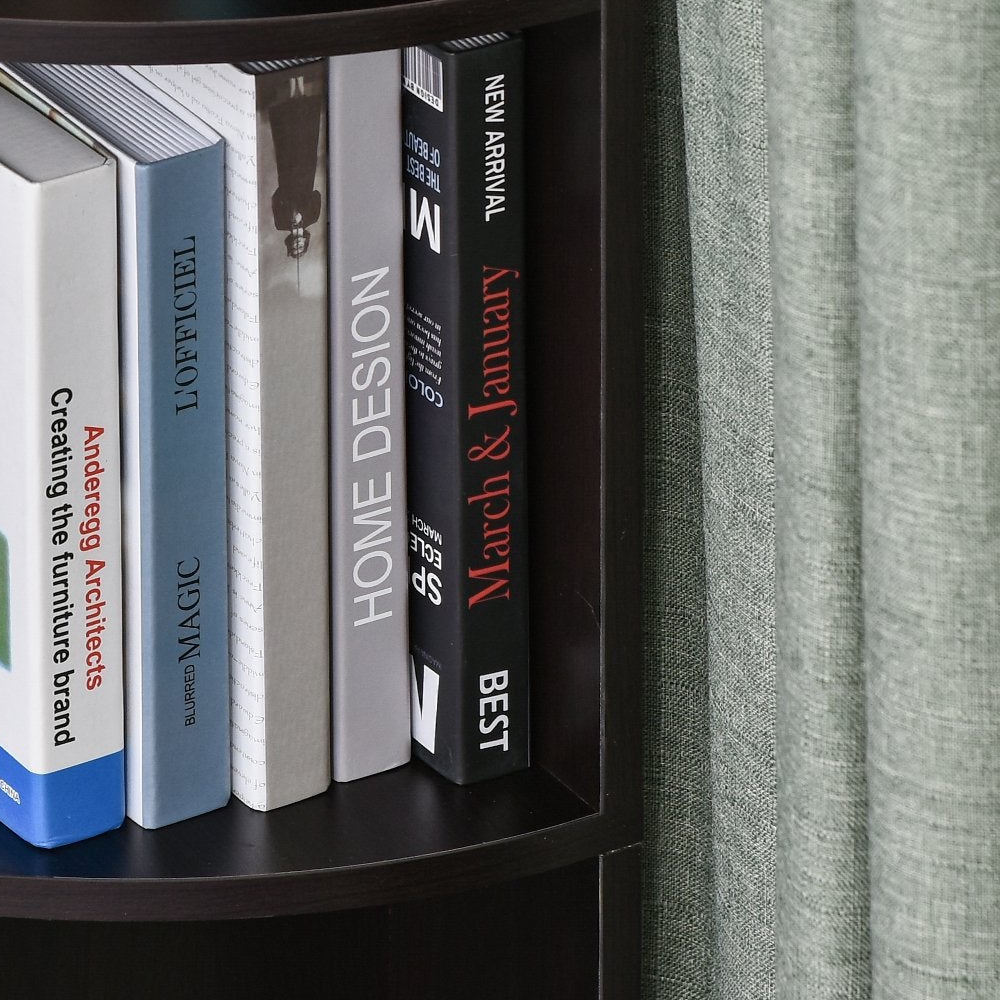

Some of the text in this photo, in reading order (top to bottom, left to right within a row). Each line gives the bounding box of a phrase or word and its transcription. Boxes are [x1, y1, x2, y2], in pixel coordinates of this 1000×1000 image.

[406, 154, 441, 193] THE BEST
[429, 146, 441, 168] OF
[484, 73, 506, 222] NEW ARRIVAL
[410, 187, 441, 254] M
[173, 235, 198, 416] L'OFFICIEL
[409, 373, 444, 408] COLO
[467, 265, 520, 610] March & January
[46, 387, 76, 747] Creating the furniture brand
[79, 425, 106, 691] Anderegg Architects
[353, 472, 393, 627] HOME
[410, 531, 442, 571] ECLE
[412, 514, 443, 546] MARCH
[411, 565, 443, 606] SP
[177, 556, 201, 727] BLURRED MAGIC
[479, 668, 509, 752] BEST
